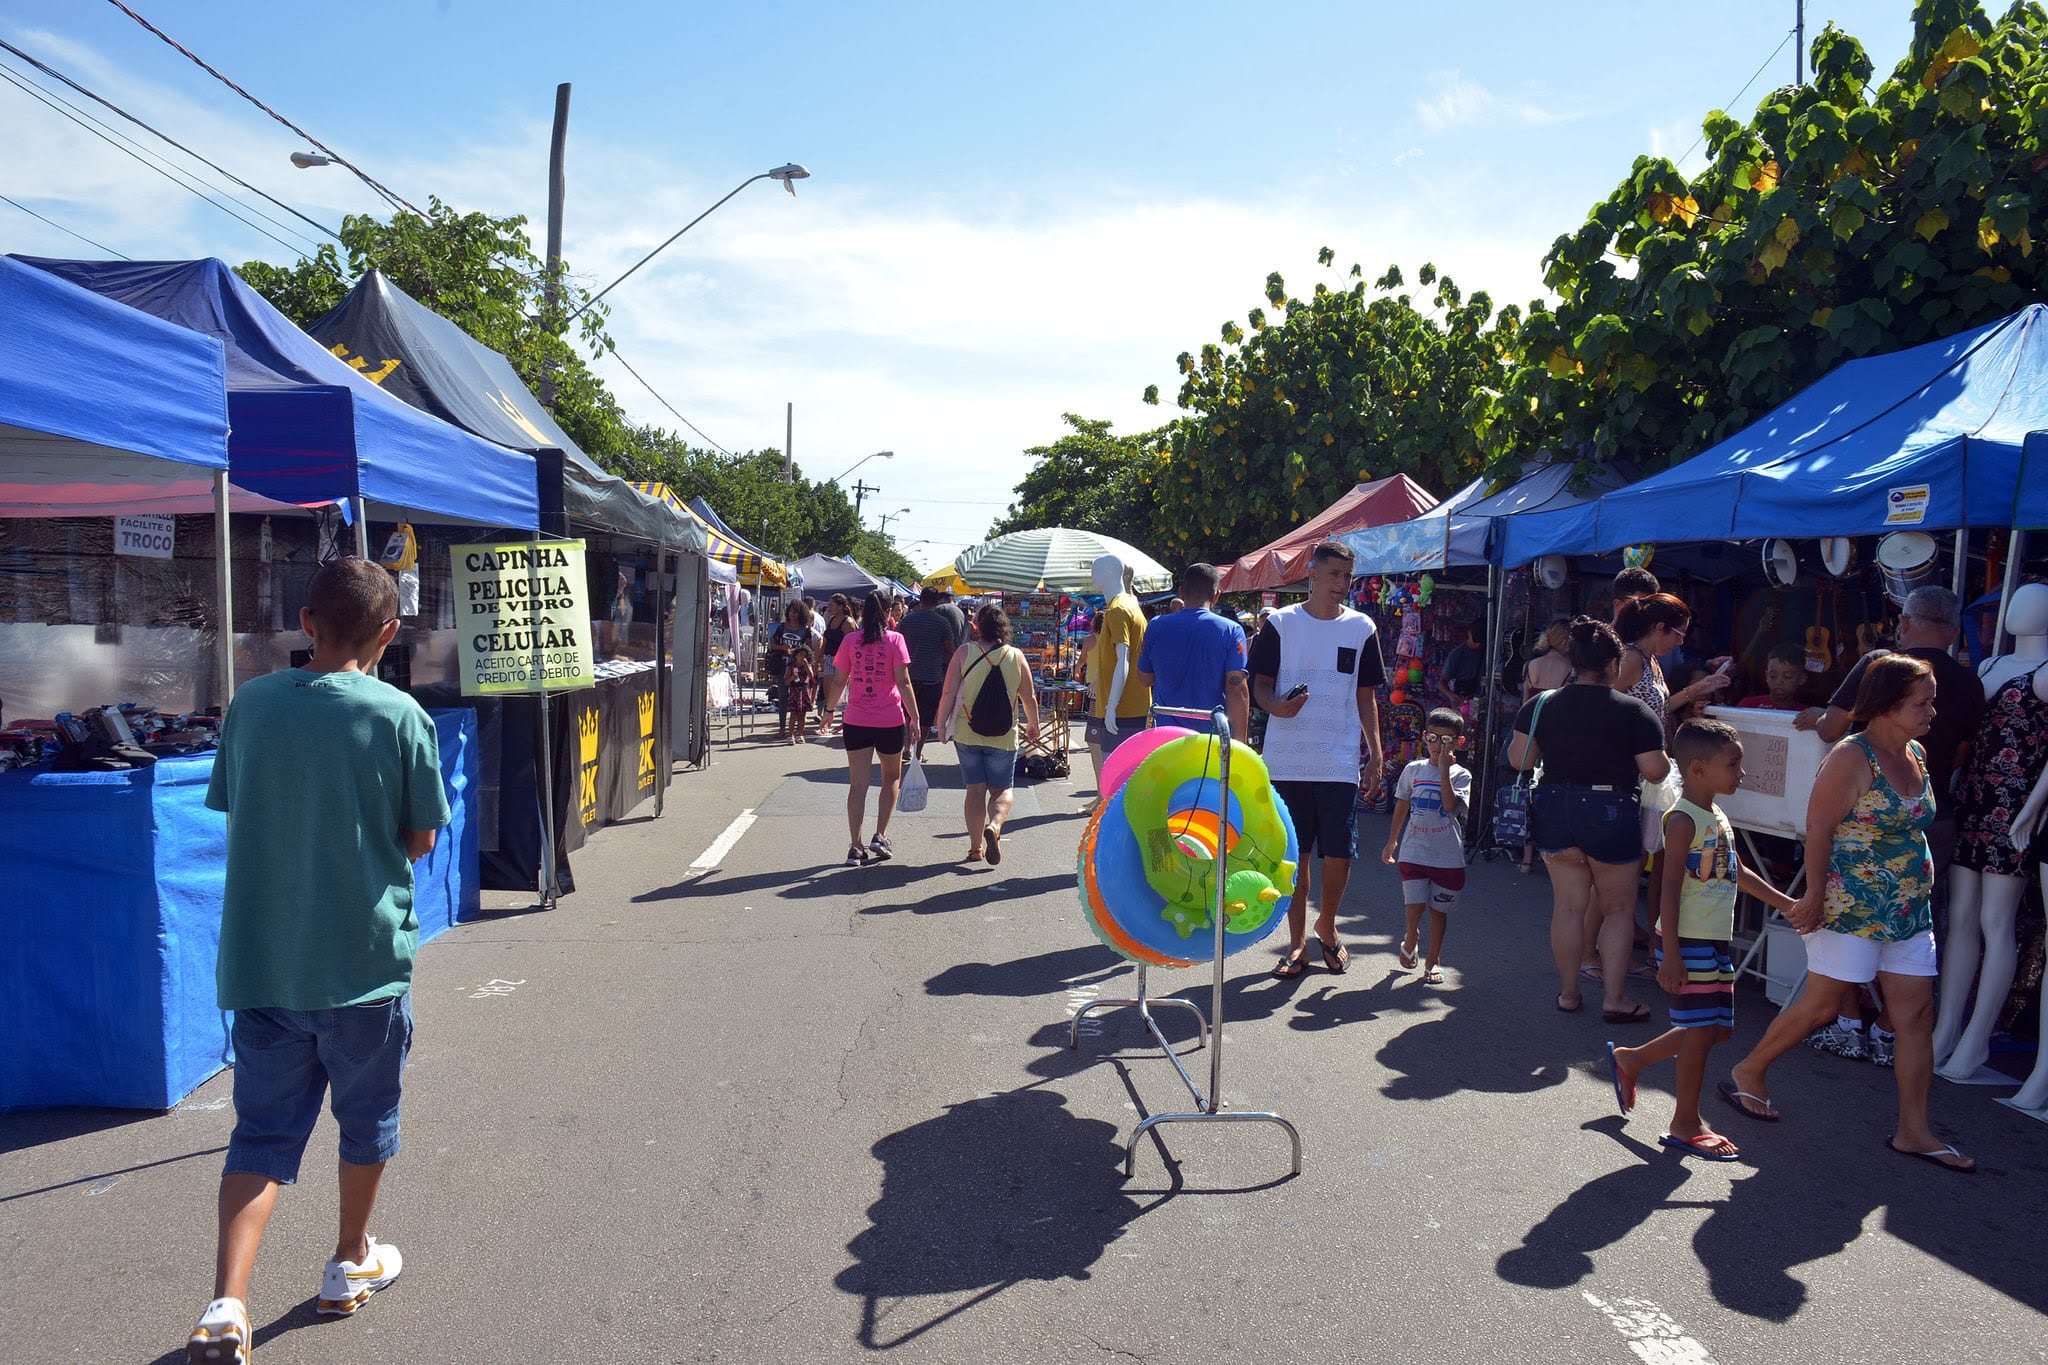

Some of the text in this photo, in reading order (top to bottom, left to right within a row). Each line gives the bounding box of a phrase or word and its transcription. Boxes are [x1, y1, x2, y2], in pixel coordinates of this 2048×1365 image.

[120, 518, 173, 533] FACILITE O
[121, 531, 172, 551] TROCO
[465, 548, 569, 572] CAPINHA
[468, 576, 571, 600] PELICULA
[471, 598, 574, 615] DE VIDRO
[492, 616, 555, 628] PARA
[472, 628, 577, 653] CELULAR
[475, 656, 515, 670] ACEITO
[565, 652, 579, 663] DE
[476, 666, 581, 684] CREDITO E DEBITO
[638, 738, 656, 777] 2K
[580, 765, 598, 812] 2K
